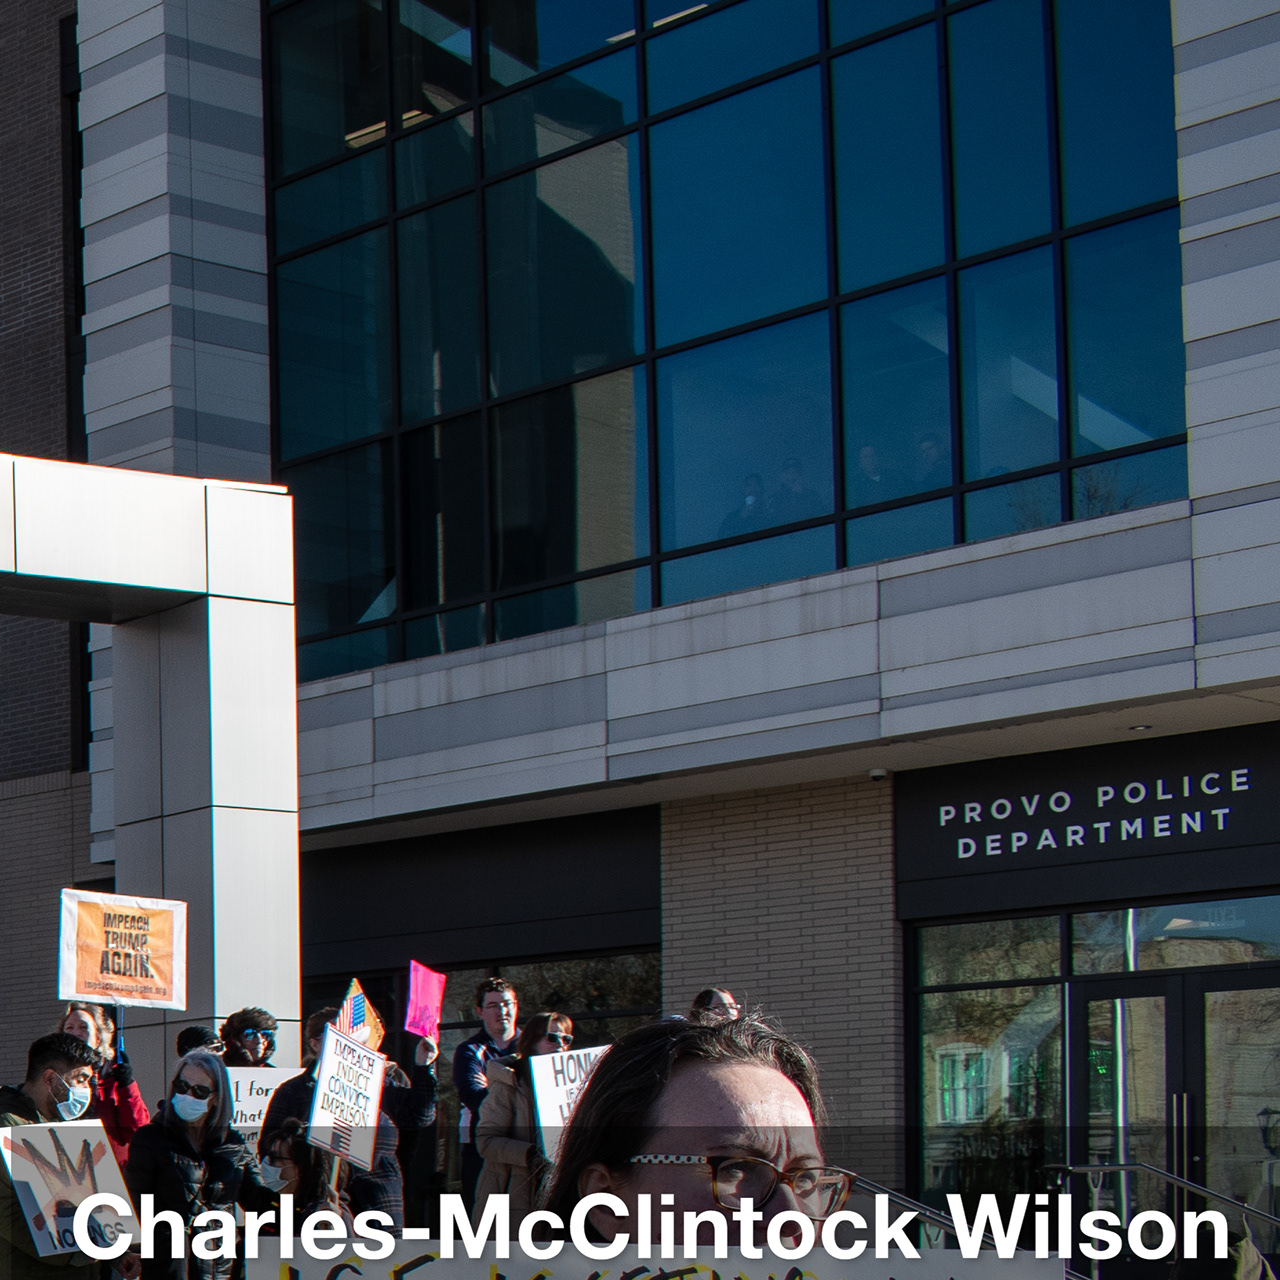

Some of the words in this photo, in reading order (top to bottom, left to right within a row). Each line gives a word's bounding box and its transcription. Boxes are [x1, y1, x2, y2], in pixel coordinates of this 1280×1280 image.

[939, 790, 1072, 827] PROVO
[1097, 767, 1252, 808] POLICE
[957, 807, 1232, 860] DEPARTMENT
[103, 912, 150, 932] IMPEACH
[100, 950, 155, 978] AGAIN.
[334, 1038, 375, 1075] IMPEACH
[328, 1076, 370, 1112] CONVICT
[337, 1061, 370, 1091] INDICT
[321, 1092, 370, 1129] IMPRISON
